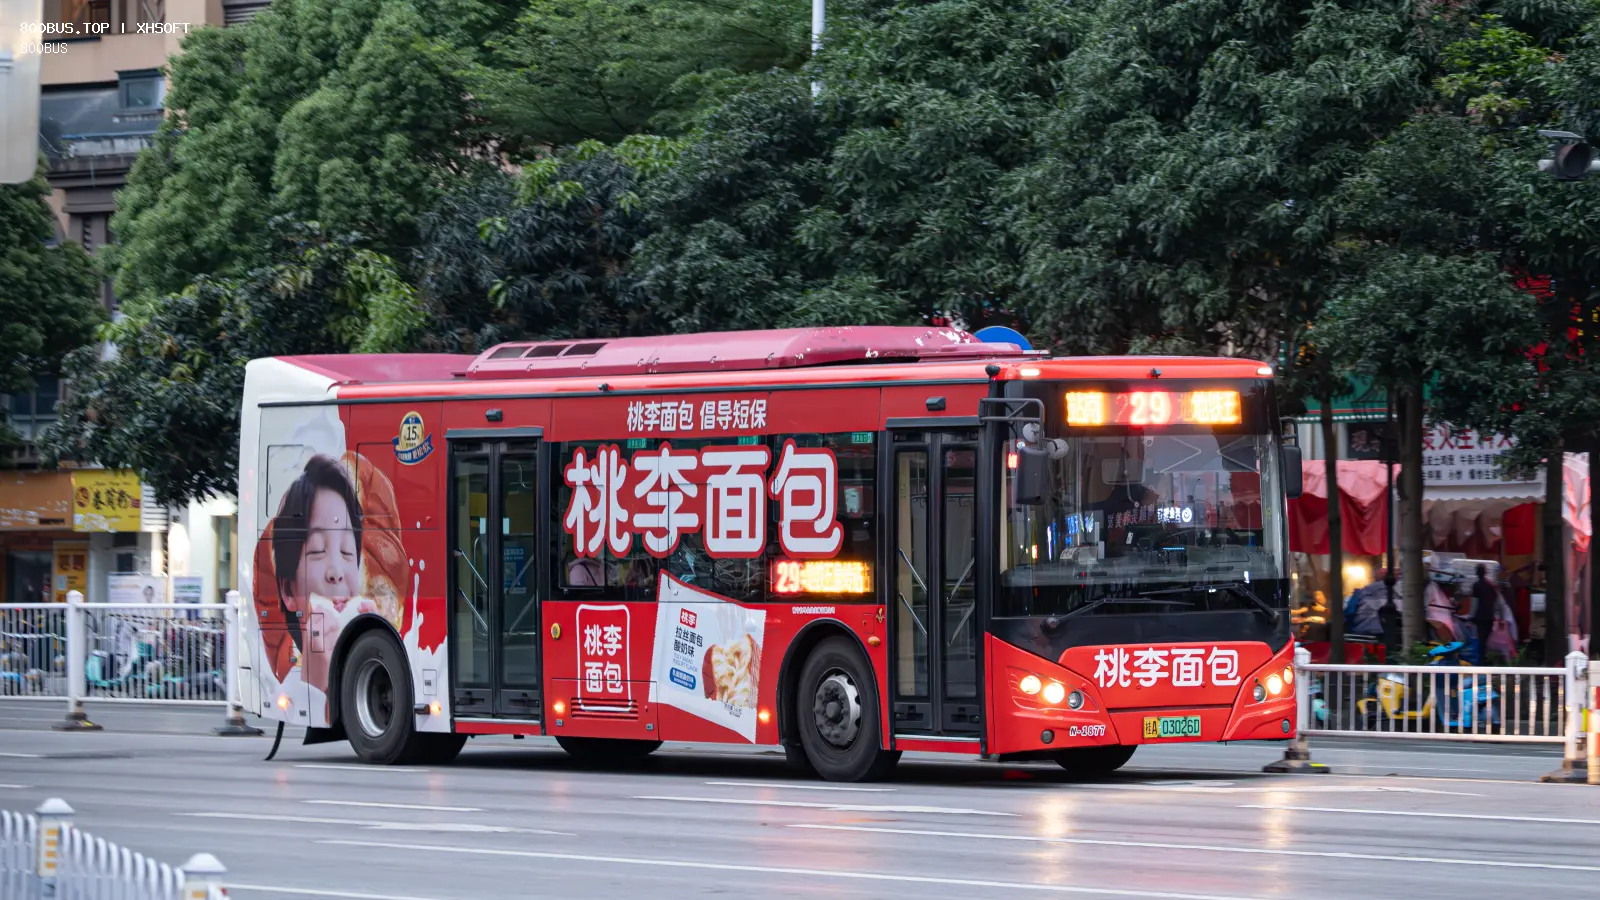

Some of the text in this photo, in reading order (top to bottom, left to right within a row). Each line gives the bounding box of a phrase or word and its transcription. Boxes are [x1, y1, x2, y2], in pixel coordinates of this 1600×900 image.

[627, 399, 767, 432] 桃李面包 倡导短保
[1130, 391, 1169, 425] 29
[406, 425, 417, 441] 15
[565, 442, 842, 555] 桃李面包
[776, 561, 801, 593] 29
[680, 610, 696, 626] 桃李
[584, 624, 622, 656] 桃李
[673, 639, 695, 658] 酸奶味
[675, 626, 703, 648] 拉丝面包
[584, 661, 624, 694] 面包
[1092, 646, 1241, 688] 桃李面包
[1069, 725, 1106, 737] N-1877
[1145, 718, 1200, 736] 桂A 03026D
